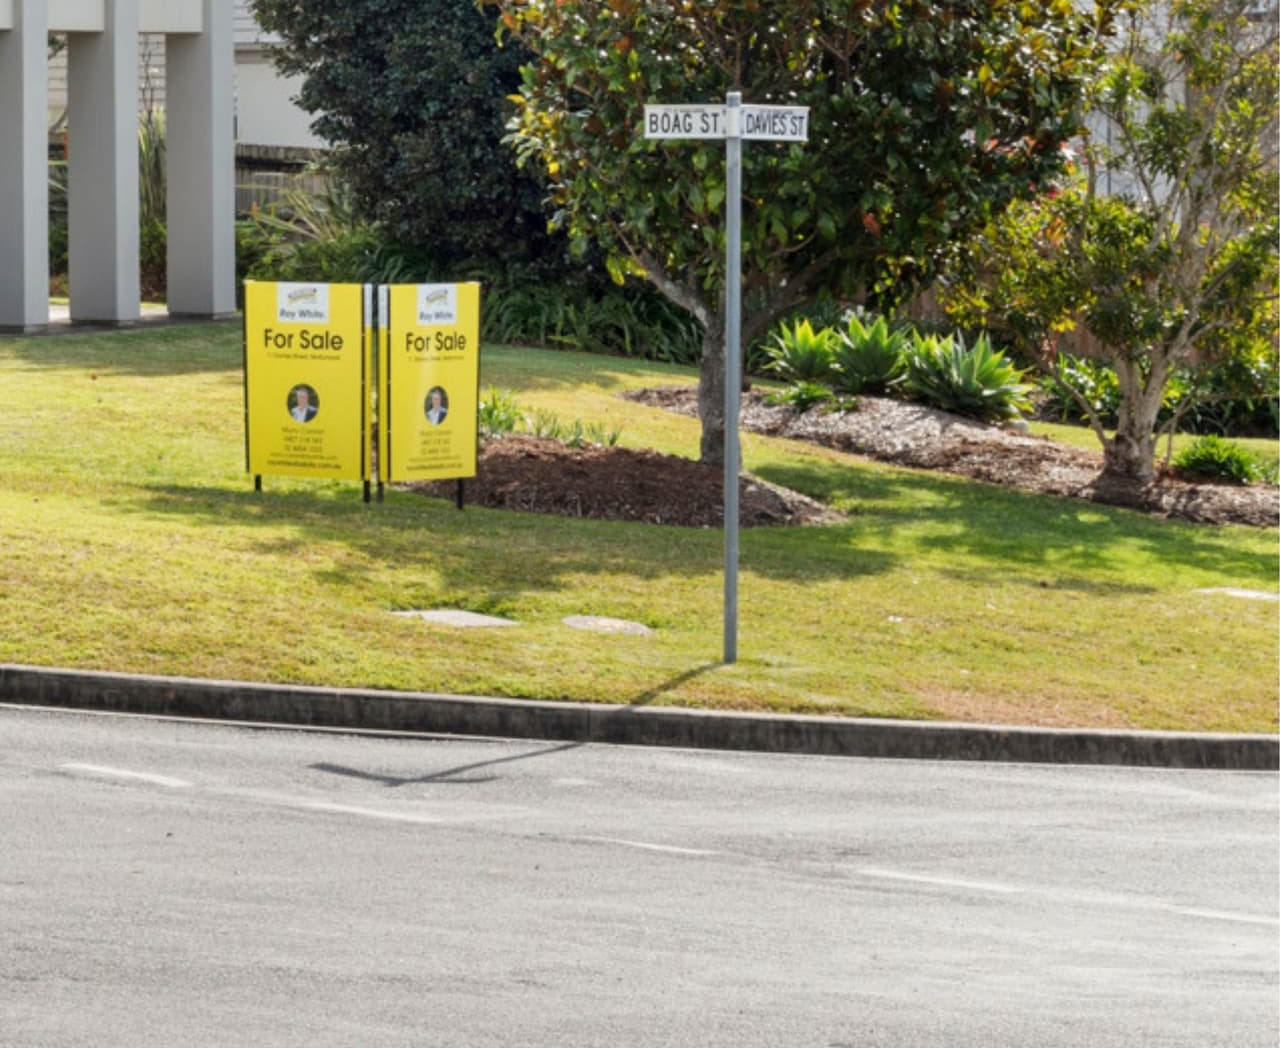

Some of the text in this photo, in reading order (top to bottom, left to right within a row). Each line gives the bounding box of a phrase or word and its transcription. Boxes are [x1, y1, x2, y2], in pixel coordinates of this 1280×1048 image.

[649, 113, 720, 134] BOAG ST
[746, 113, 805, 136] DAVIES ST
[264, 328, 344, 351] For Sale
[406, 331, 466, 352] For Sale
